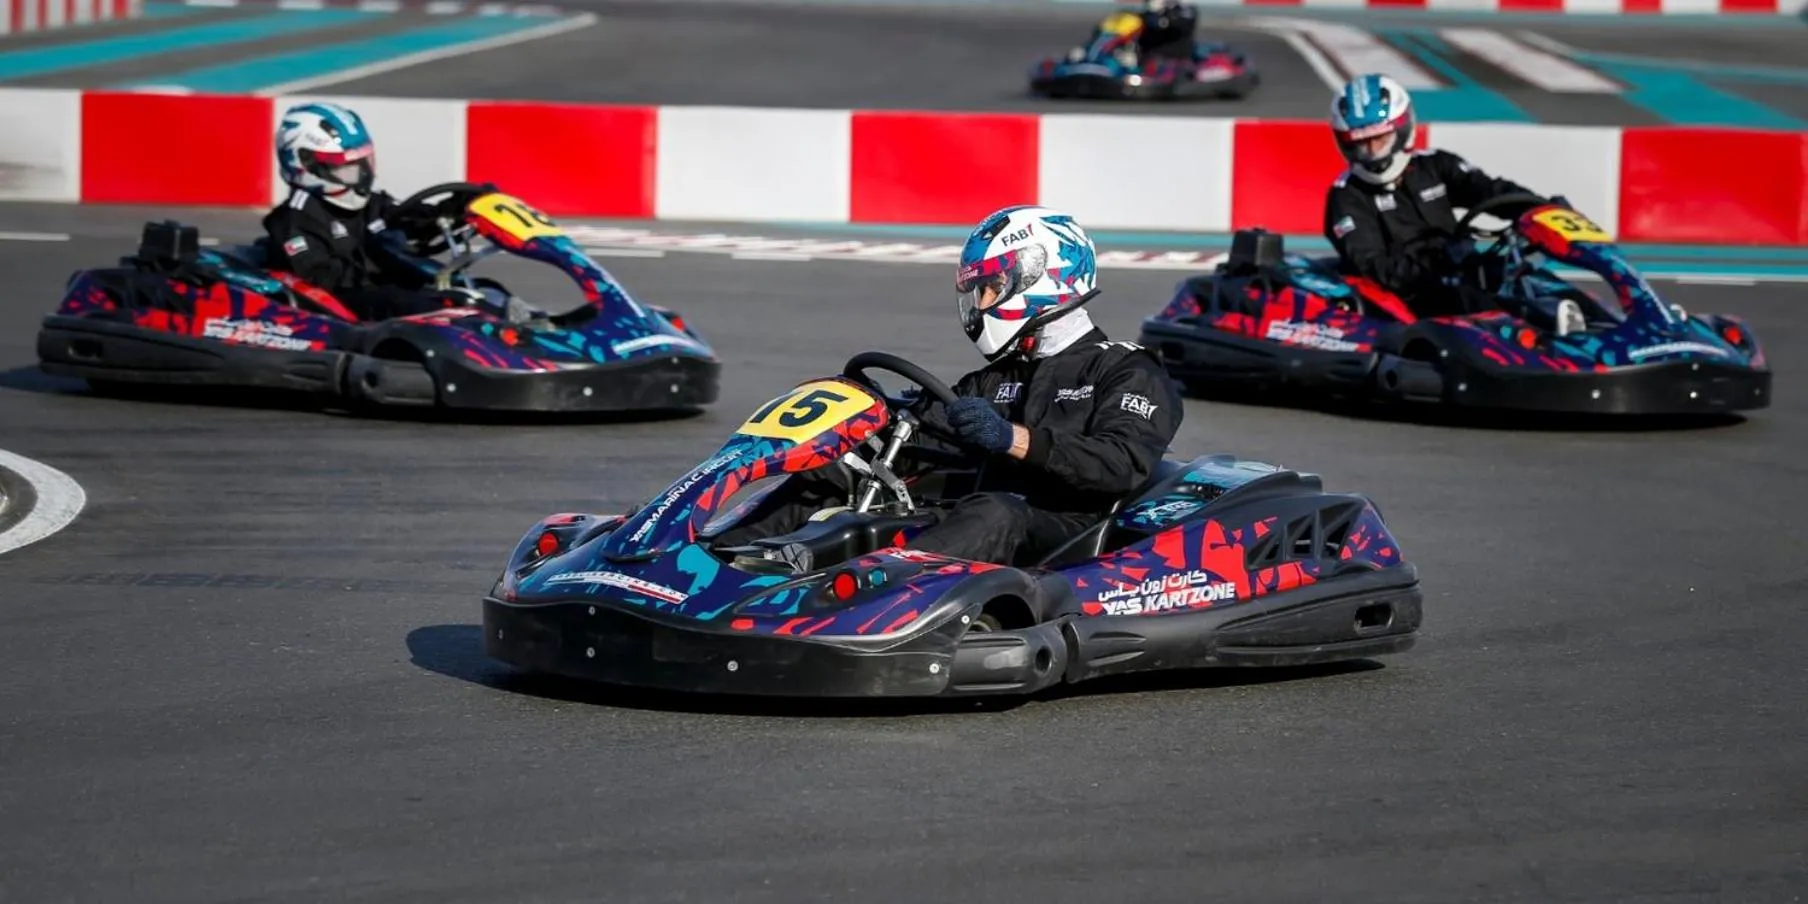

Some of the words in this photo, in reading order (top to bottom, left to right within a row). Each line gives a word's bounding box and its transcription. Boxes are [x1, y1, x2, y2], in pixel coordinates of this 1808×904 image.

[749, 389, 849, 428] 15
[649, 480, 696, 524] MARINA
[1102, 597, 1143, 616] YAS
